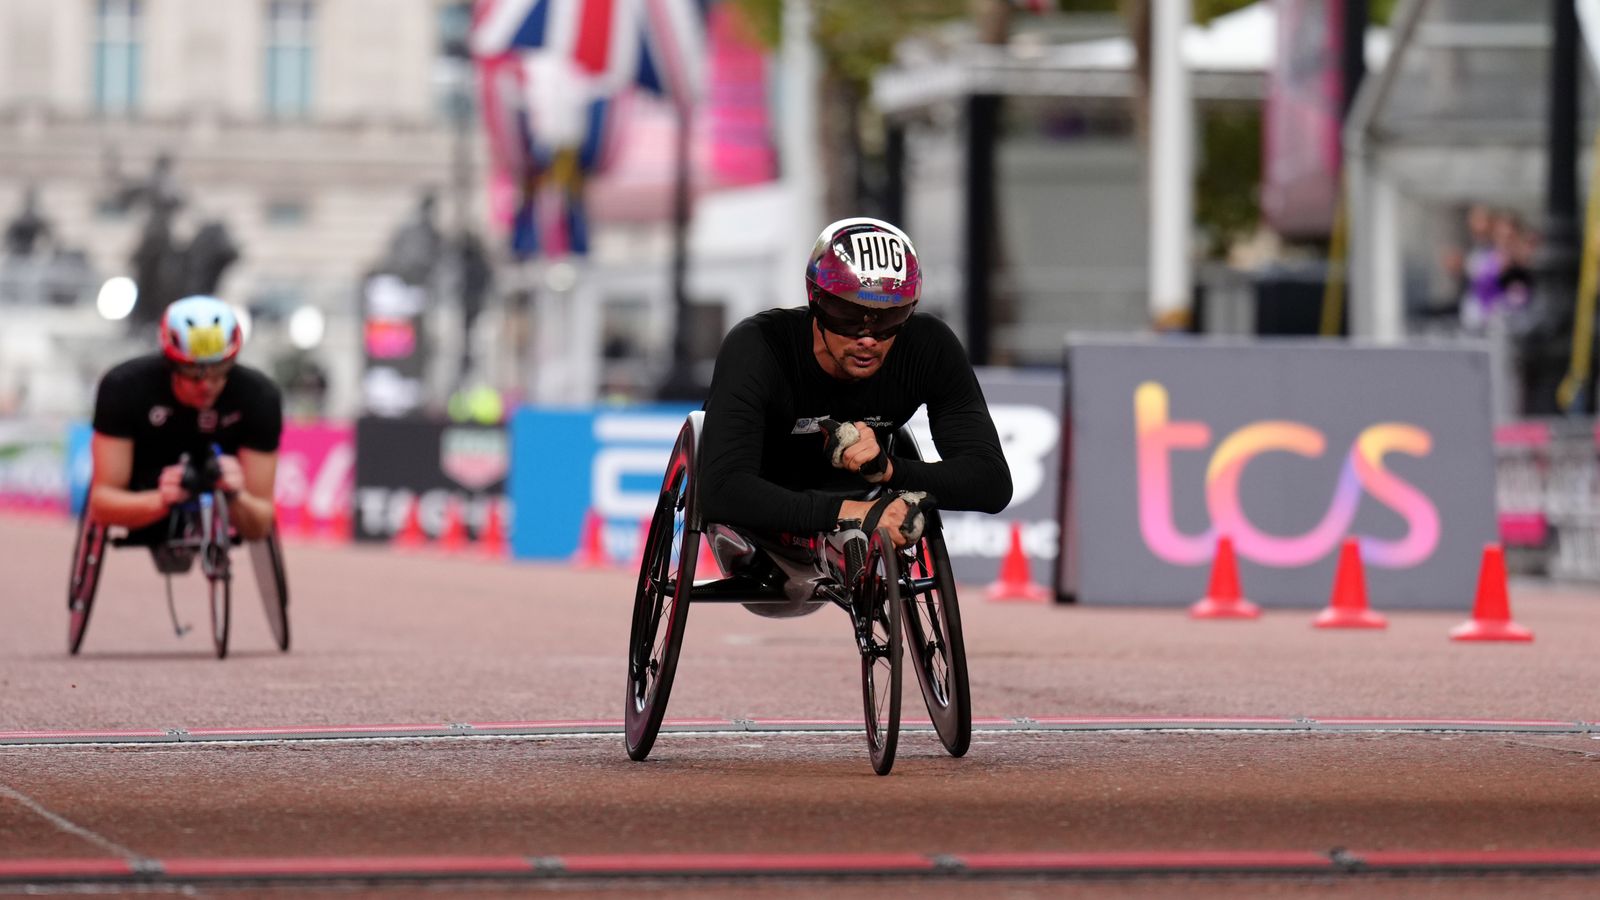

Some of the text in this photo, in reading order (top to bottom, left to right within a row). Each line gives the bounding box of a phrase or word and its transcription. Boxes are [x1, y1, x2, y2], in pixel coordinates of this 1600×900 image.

[857, 236, 903, 273] HUG
[856, 290, 889, 303] Allianz
[1134, 380, 1441, 569] tcs
